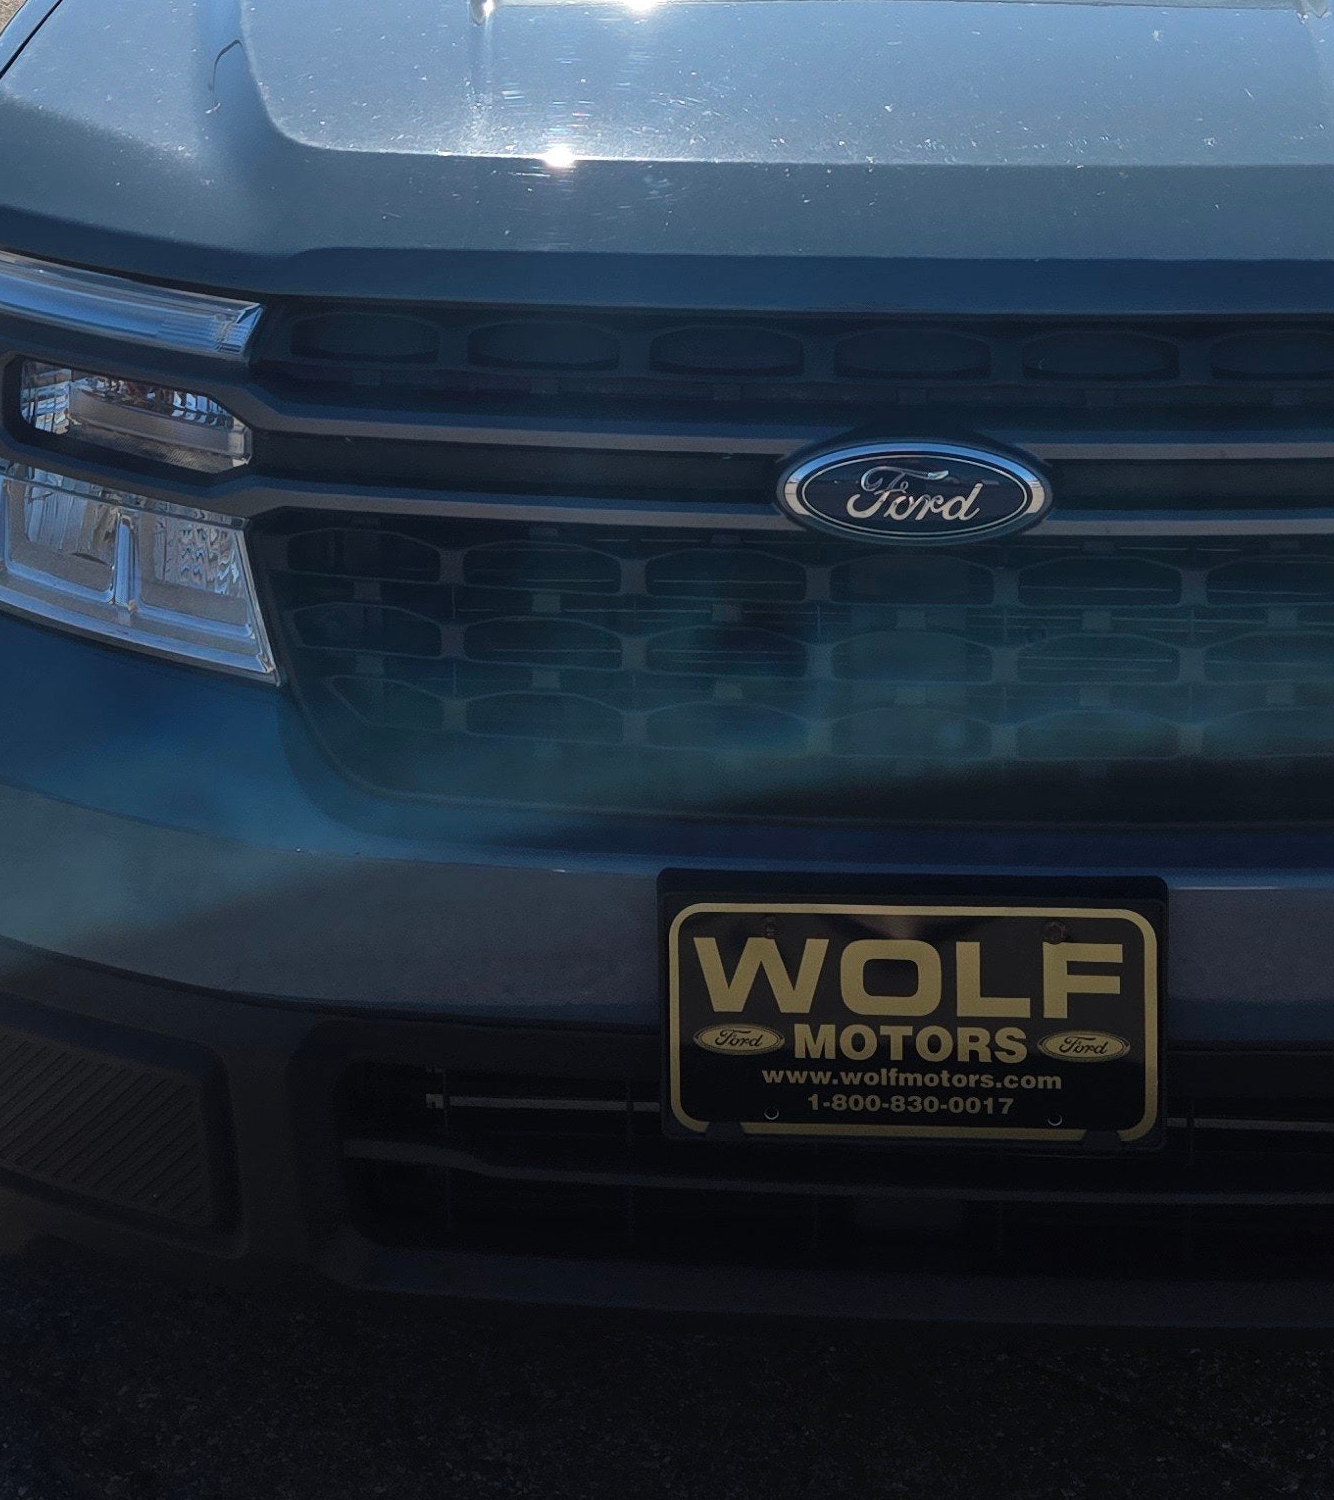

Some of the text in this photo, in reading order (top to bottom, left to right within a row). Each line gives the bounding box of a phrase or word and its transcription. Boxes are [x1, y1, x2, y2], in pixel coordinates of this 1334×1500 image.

[846, 465, 984, 521] Ford
[692, 936, 1124, 1019] WOLF
[714, 1030, 763, 1049] Ford
[792, 1023, 1028, 1064] MOTORS
[1058, 1037, 1109, 1056] Ford
[761, 1068, 1063, 1090] www.wolfmotors.com
[807, 1093, 1014, 1115] 1-800-830-0017
